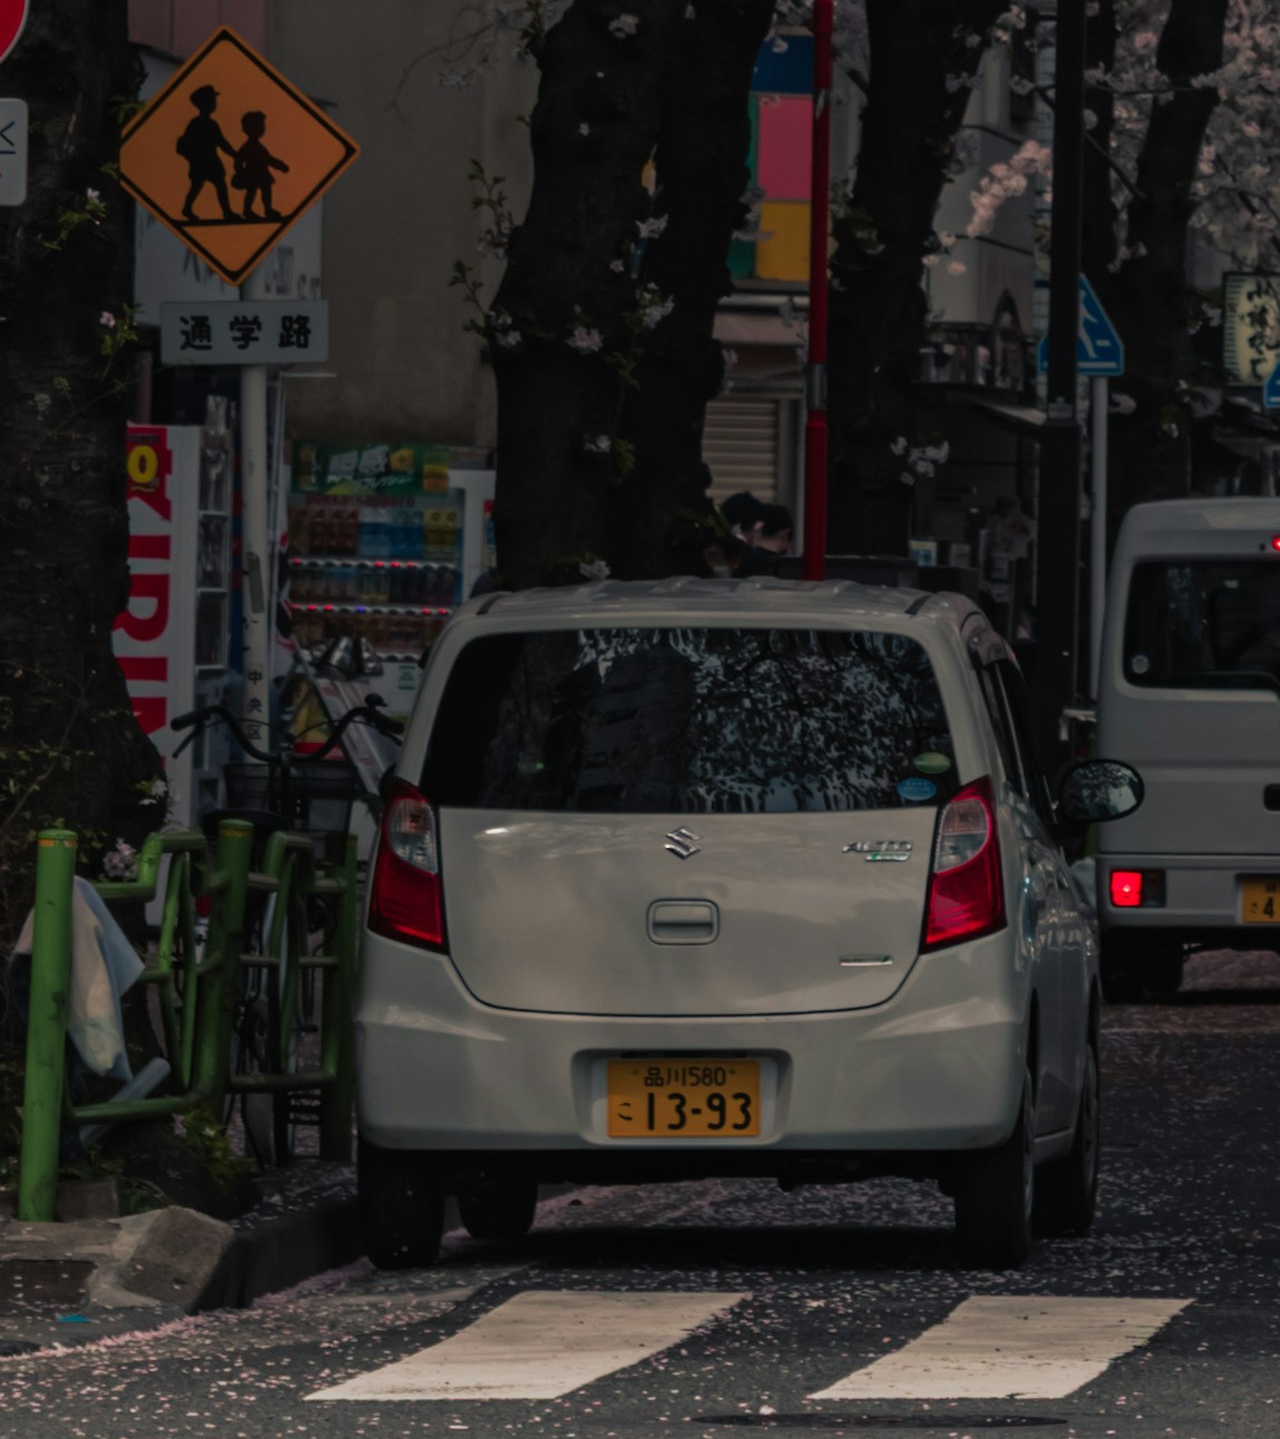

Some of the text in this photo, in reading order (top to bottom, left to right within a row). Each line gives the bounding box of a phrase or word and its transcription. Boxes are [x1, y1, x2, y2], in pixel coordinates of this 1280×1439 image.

[179, 315, 312, 350] 通学路
[248, 670, 263, 740] 中央区
[618, 1092, 752, 1131] こ 13-93
